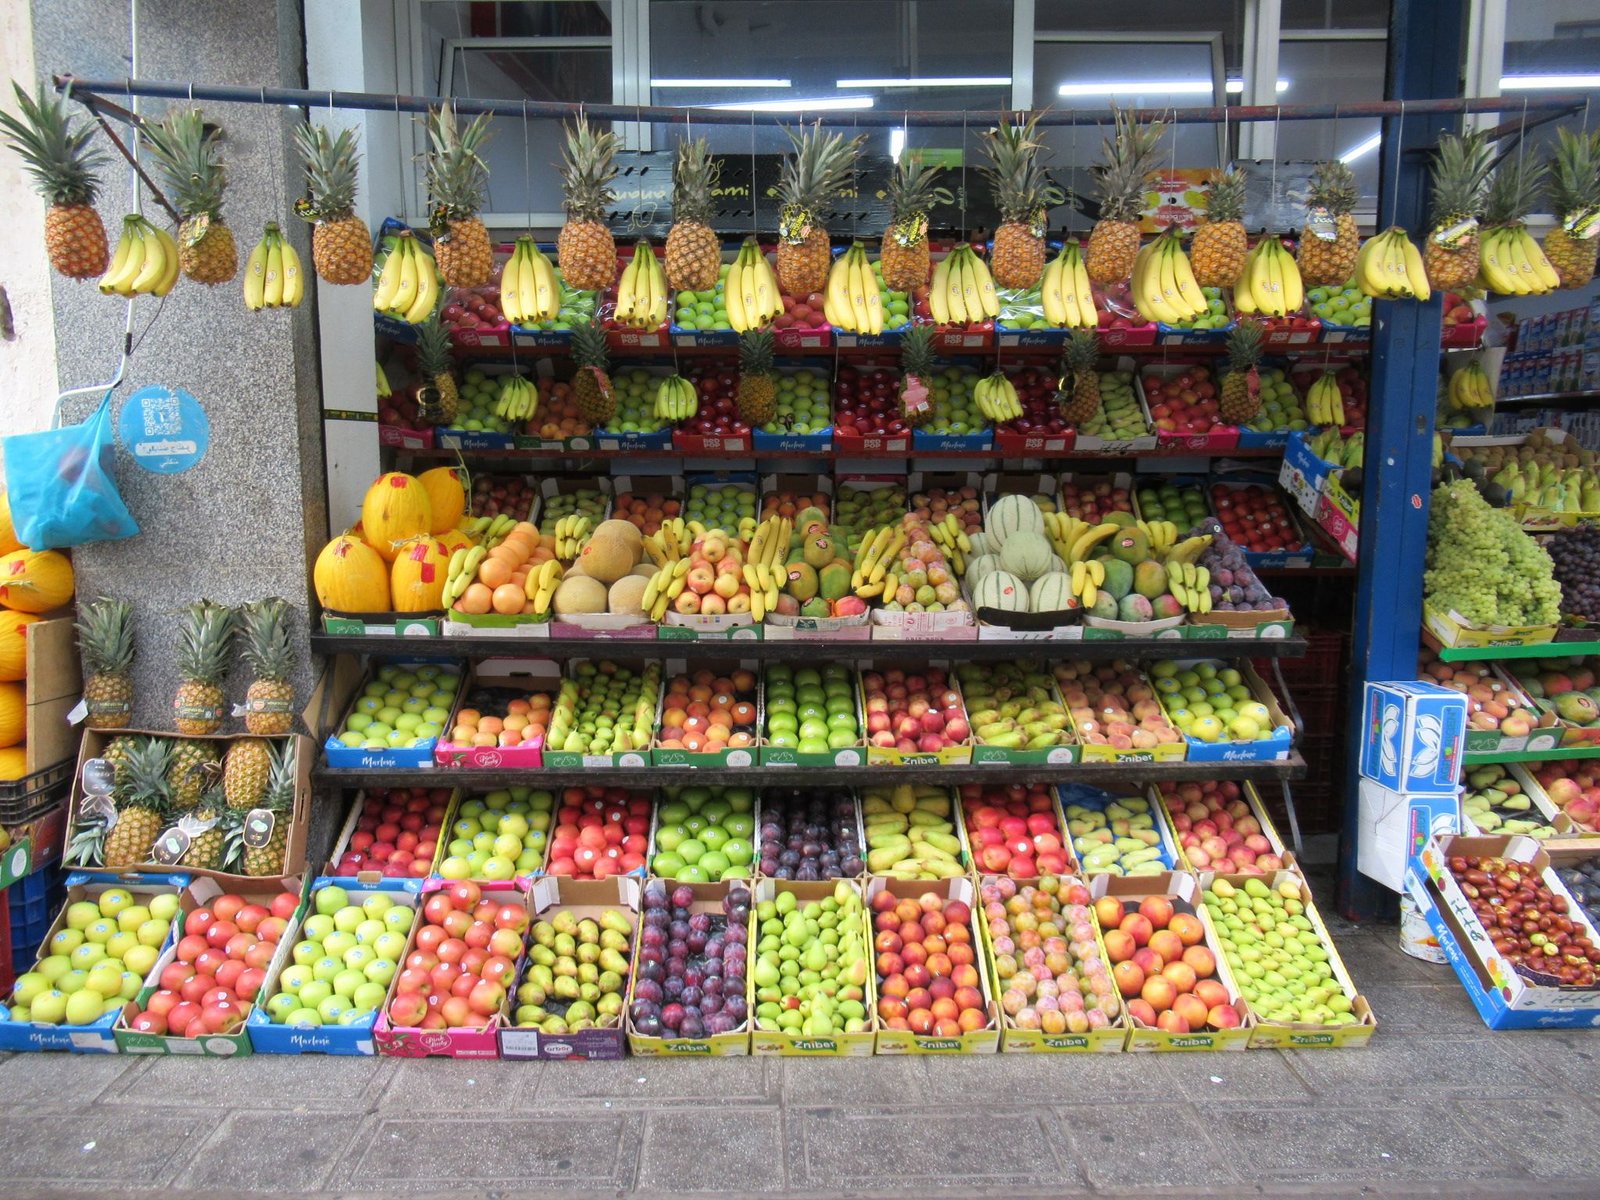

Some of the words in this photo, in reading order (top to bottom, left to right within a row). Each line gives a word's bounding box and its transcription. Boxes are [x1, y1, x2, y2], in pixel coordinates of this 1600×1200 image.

[1118, 754, 1153, 763] Zniber
[1223, 750, 1257, 760] Marlene
[362, 756, 397, 768] Marlene
[902, 756, 939, 765] Zniber
[1437, 922, 1460, 963] Marlene
[290, 1034, 331, 1048] Marlene
[1046, 1037, 1086, 1048] Zniber
[1172, 1037, 1212, 1047] Zniber
[1292, 1034, 1333, 1044] Zniber
[671, 1043, 708, 1052] Zniber
[794, 1040, 836, 1050] Zniber
[919, 1040, 961, 1050] Zniber
